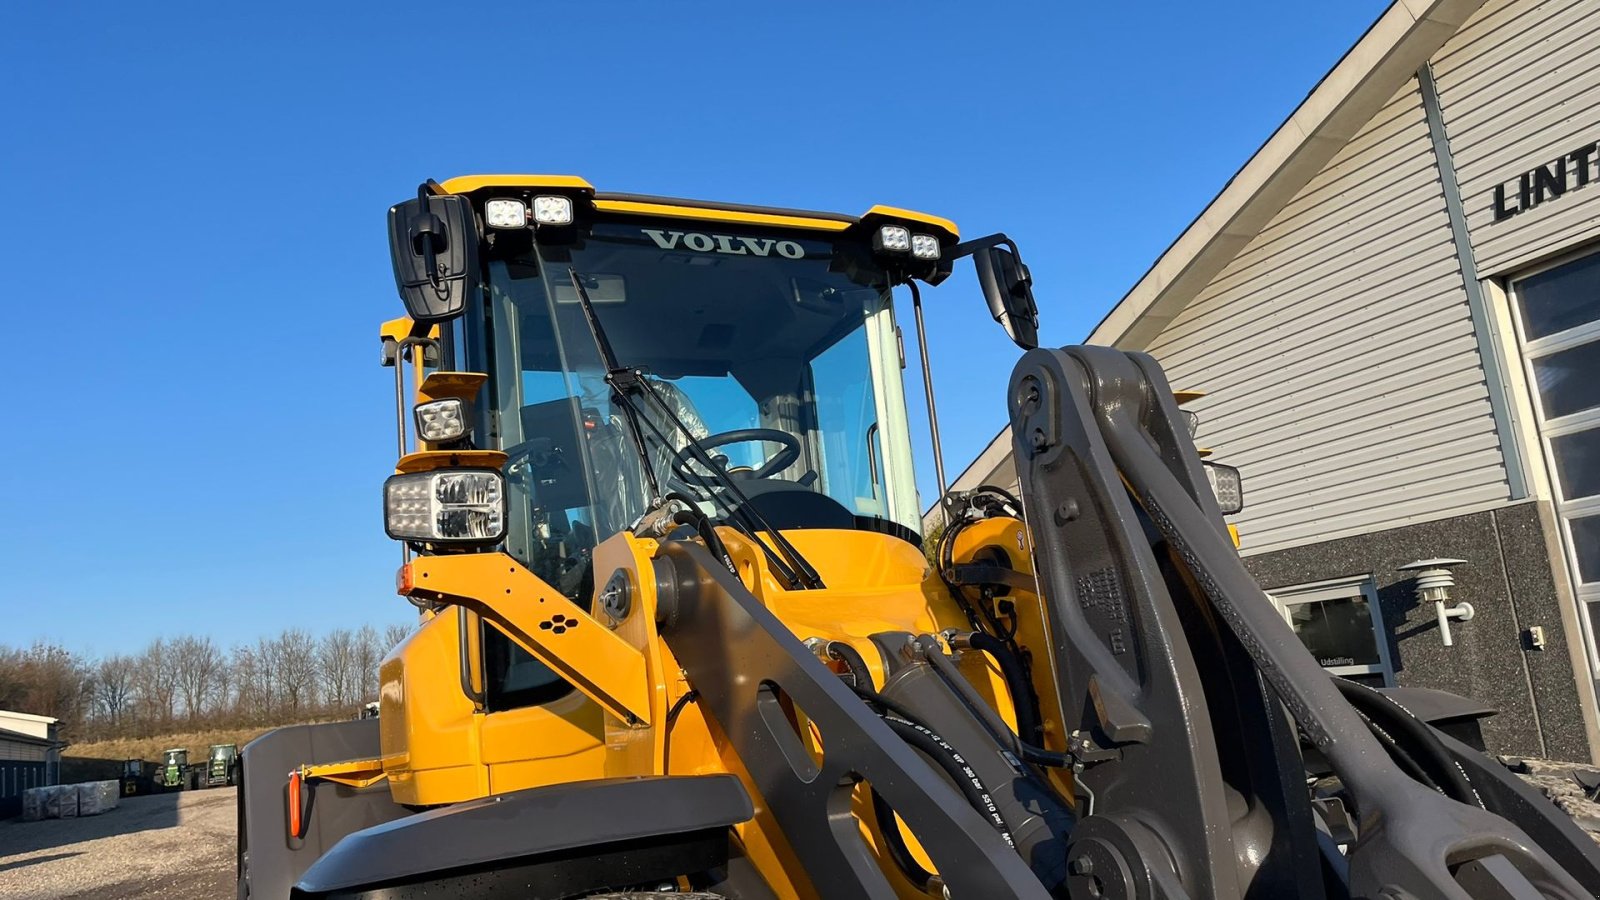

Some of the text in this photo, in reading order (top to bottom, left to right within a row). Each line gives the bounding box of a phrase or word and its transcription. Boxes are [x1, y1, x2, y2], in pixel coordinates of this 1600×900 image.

[641, 229, 805, 259] VOLVO
[1320, 656, 1354, 666] Udstilling
[953, 753, 965, 764] WP
[971, 778, 983, 791] bar
[981, 793, 996, 812] 5510
[991, 812, 1004, 825] psi
